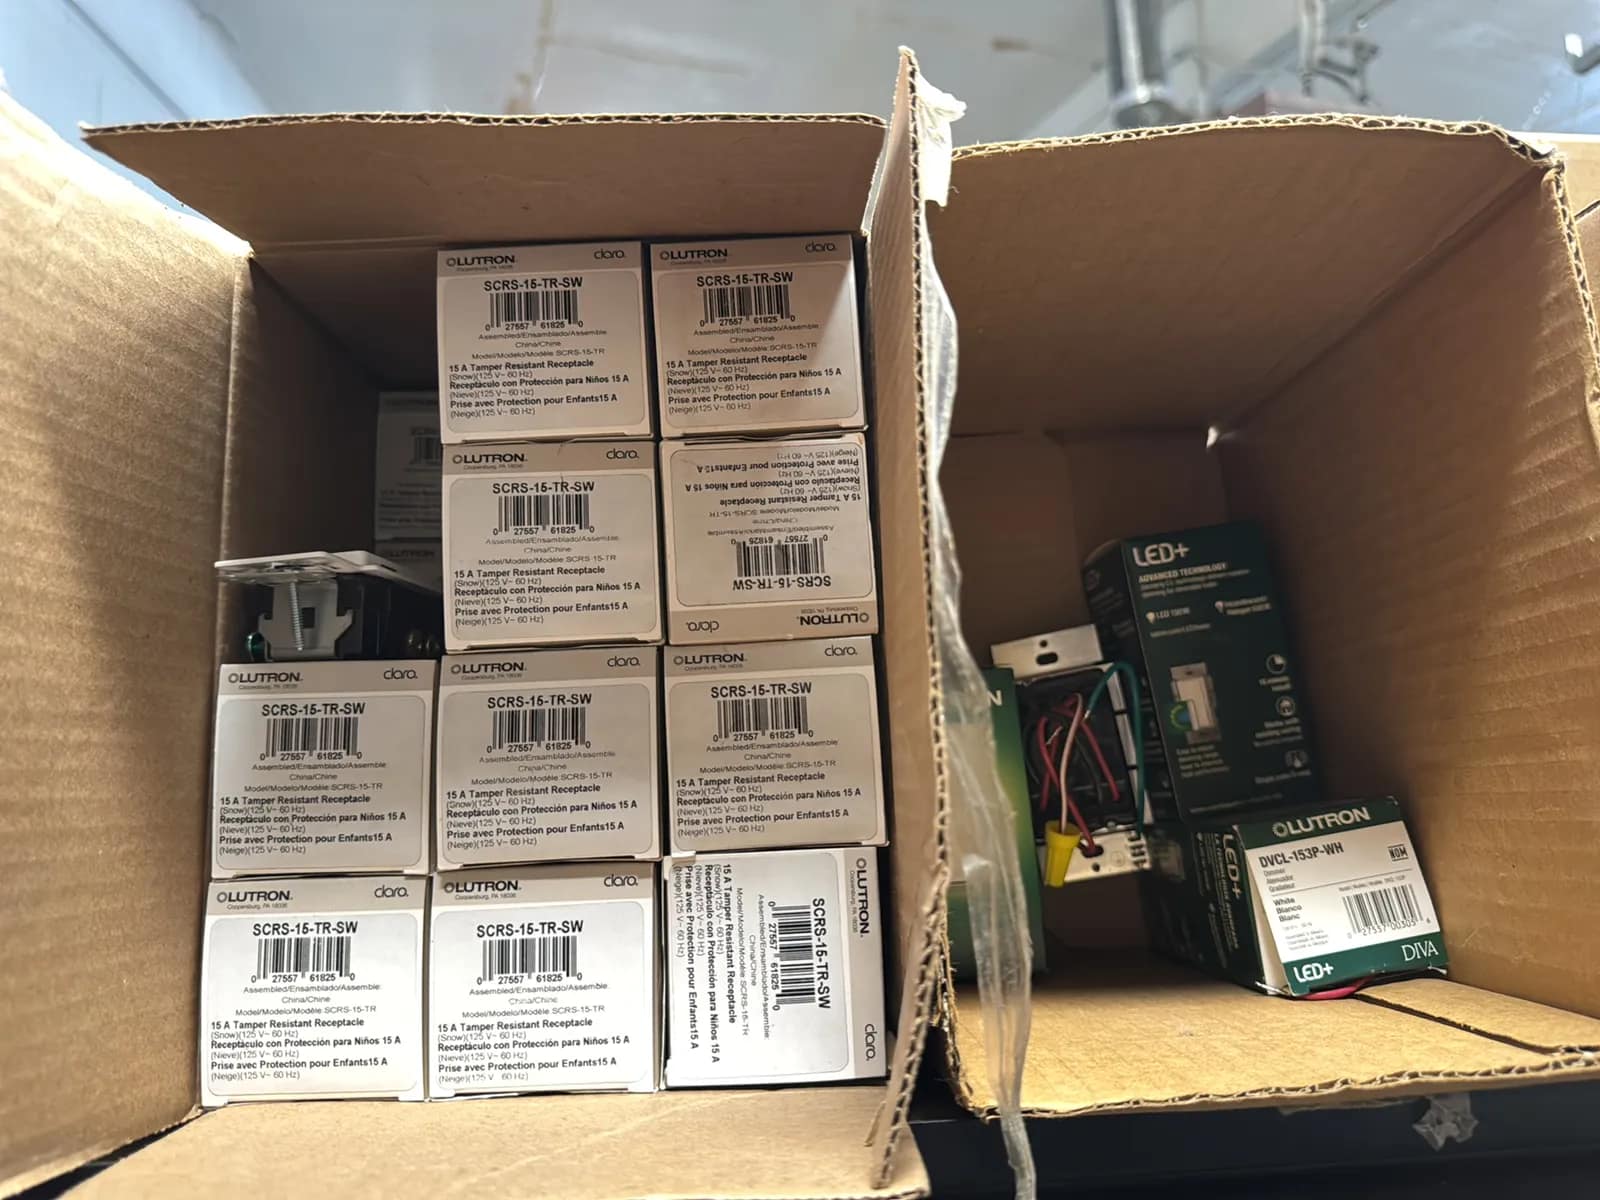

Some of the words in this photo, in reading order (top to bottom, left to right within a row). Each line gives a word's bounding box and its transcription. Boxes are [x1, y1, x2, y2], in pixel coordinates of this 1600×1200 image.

[456, 255, 515, 266] LUTRON
[669, 248, 728, 259] LUTRON
[485, 276, 583, 290] SCRS-15-TR-SW
[697, 271, 794, 286] SCRS-15-TR-SW
[505, 322, 530, 331] 27557
[540, 321, 565, 329] 61825
[449, 364, 459, 372] 15
[461, 364, 467, 372] A
[470, 362, 503, 373] Tamper
[505, 360, 545, 370] Resistant
[547, 359, 594, 370] Receptacle
[665, 360, 676, 369] 15
[677, 360, 684, 368] A
[686, 358, 718, 369] Tamper
[720, 355, 759, 366] Resistant
[761, 353, 807, 365] Receptacle
[464, 453, 524, 463] LUTRON
[605, 447, 638, 459] claro
[493, 480, 595, 494] SCRS-15-TR-SW
[719, 496, 767, 507] Receptacle
[768, 495, 808, 505] Resistant
[809, 492, 842, 503] Tamper
[844, 493, 850, 502] A
[852, 493, 862, 501] 15
[513, 527, 539, 536] 27557
[550, 526, 576, 534] 61825
[1132, 542, 1190, 567] LED+
[454, 570, 465, 579] 15
[467, 570, 473, 578] A
[476, 568, 510, 580] Tamper
[512, 567, 554, 577] Resistant
[556, 565, 606, 577] Receptacle
[732, 575, 831, 591] SCRS-15-TR-SW
[799, 613, 859, 626] LUTRON
[824, 644, 857, 657] claro
[607, 654, 640, 667] claro
[684, 653, 744, 665] LUTRON
[383, 666, 417, 680] claro
[462, 662, 524, 673] LUTRON
[239, 672, 300, 683] LUTRON
[712, 682, 813, 698] SCRS-15-TR-SW
[488, 692, 592, 709] SCRS-15-TR-SW
[262, 702, 365, 716] SCRS-15-TR-SW
[733, 732, 758, 742] 27557
[769, 730, 795, 739] 61825
[508, 743, 533, 753] 27557
[545, 741, 572, 751] 61825
[280, 752, 305, 761] 27557
[317, 751, 343, 760] 61825
[676, 778, 687, 788] 15
[688, 778, 695, 787] A
[698, 776, 731, 788] Tamper
[733, 774, 774, 785] Resistant
[776, 771, 825, 784] Receptacle
[447, 790, 457, 800] 15
[459, 790, 466, 799] A
[469, 788, 504, 801] Tamper
[506, 786, 549, 797] Resistant
[551, 783, 601, 796] Receptacle
[220, 796, 230, 805] 15
[232, 796, 239, 805] A
[242, 796, 275, 807] Tamper
[277, 795, 319, 805] Resistant
[321, 794, 370, 805] Receptacle
[1286, 806, 1371, 835] LUTRON
[1259, 842, 1344, 868] DVCL-153P-WH
[723, 863, 732, 874] 15
[1223, 834, 1242, 899] LED+
[603, 872, 638, 887] claro
[685, 866, 694, 890] Prise
[374, 884, 408, 898] claro
[455, 880, 518, 893] LUTRON
[228, 890, 290, 902] LUTRON
[686, 892, 694, 914] avec
[722, 885, 733, 921] Tamper
[857, 868, 870, 935] LUTRON
[1273, 897, 1295, 906] White
[1276, 904, 1302, 913] Blanco
[1279, 913, 1300, 921] Blanc
[253, 920, 358, 936] SCRS-15-TR-SW
[477, 920, 584, 937] SCRS-15-TR-SW
[687, 916, 696, 965] Protection
[768, 922, 778, 950] 27557
[725, 923, 735, 968] Resistant
[1402, 940, 1439, 961] DIVA
[813, 898, 831, 1011] SCRS-15-TR-SW
[272, 974, 298, 983] 27557
[309, 973, 336, 982] 61825
[498, 975, 524, 985] 27557
[536, 973, 563, 983] 61825
[687, 967, 696, 990] pour
[770, 961, 780, 990] 61825
[1293, 964, 1334, 983] LED+
[725, 970, 737, 1024] Receptacle
[211, 1020, 221, 1030] 15
[224, 1020, 230, 1030] A
[233, 1019, 267, 1031] Tamper
[270, 1018, 312, 1029] Resistant
[314, 1017, 364, 1029] Receptacle
[437, 1023, 448, 1033] 15
[450, 1023, 457, 1032] A
[460, 1021, 495, 1034] Tamper
[497, 1019, 540, 1030] Resistant
[542, 1017, 593, 1030] Receptacle
[266, 1040, 281, 1048] con
[284, 1036, 330, 1047] Protección
[333, 1038, 352, 1048] para
[354, 1035, 380, 1046] Niños
[383, 1035, 392, 1045] 15
[395, 1035, 401, 1044] A
[691, 1043, 699, 1051] A
[865, 1023, 879, 1060] claro
[211, 1060, 234, 1070] Prise
[237, 1061, 257, 1069] avec
[260, 1059, 306, 1069] Protection
[309, 1060, 330, 1069] pour
[381, 1057, 388, 1066] A
[438, 1063, 462, 1073] Prise
[465, 1064, 485, 1072] avec
[488, 1060, 535, 1071] Protection
[538, 1061, 560, 1071] pour
[610, 1057, 617, 1065] A
